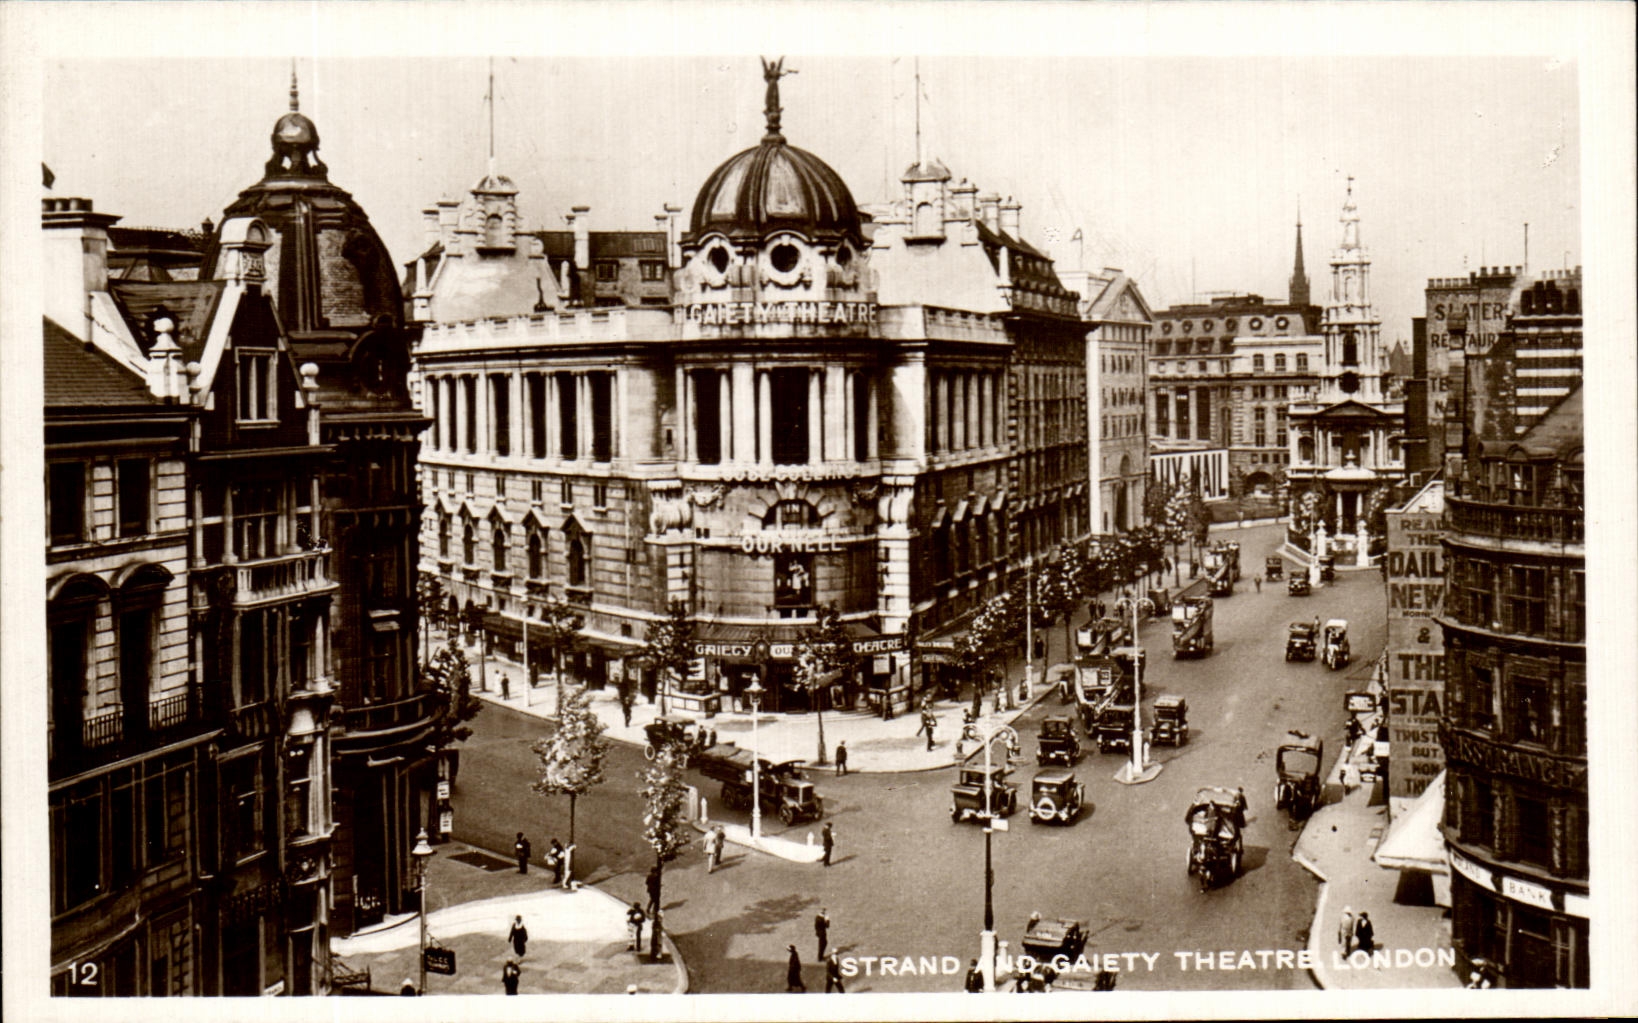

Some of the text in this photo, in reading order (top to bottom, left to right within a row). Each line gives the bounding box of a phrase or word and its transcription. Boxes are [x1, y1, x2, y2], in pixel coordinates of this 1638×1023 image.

[690, 301, 877, 324] GAIETY THEATRE
[742, 535, 842, 553] OUR NELL
[1407, 533, 1440, 546] THE
[1389, 551, 1444, 579] DAIL
[1390, 583, 1443, 610] NEW
[1417, 627, 1431, 644] &
[1390, 689, 1441, 716] STA
[1509, 882, 1547, 903] BANK
